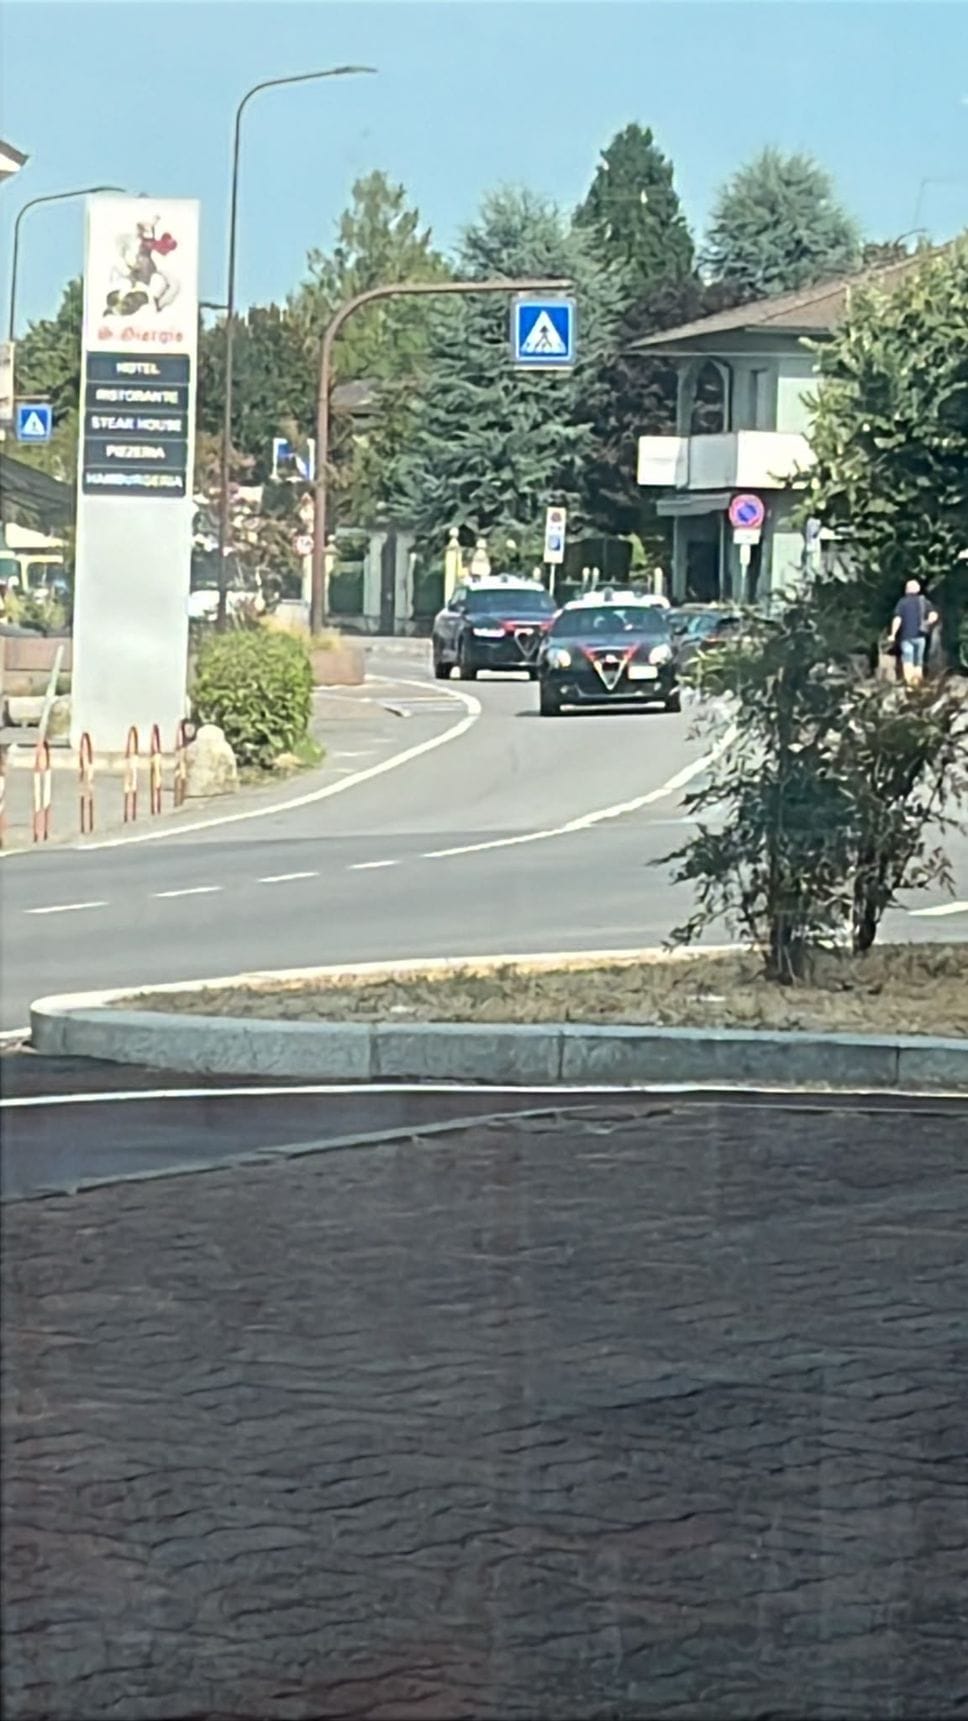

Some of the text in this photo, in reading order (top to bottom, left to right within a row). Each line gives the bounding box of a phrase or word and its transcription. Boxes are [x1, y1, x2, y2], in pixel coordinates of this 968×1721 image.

[116, 362, 161, 375] HOTEL
[96, 389, 179, 404] RISTORANTE
[91, 416, 182, 432] STEAK HOUSE
[106, 445, 166, 459] PIZZERIA
